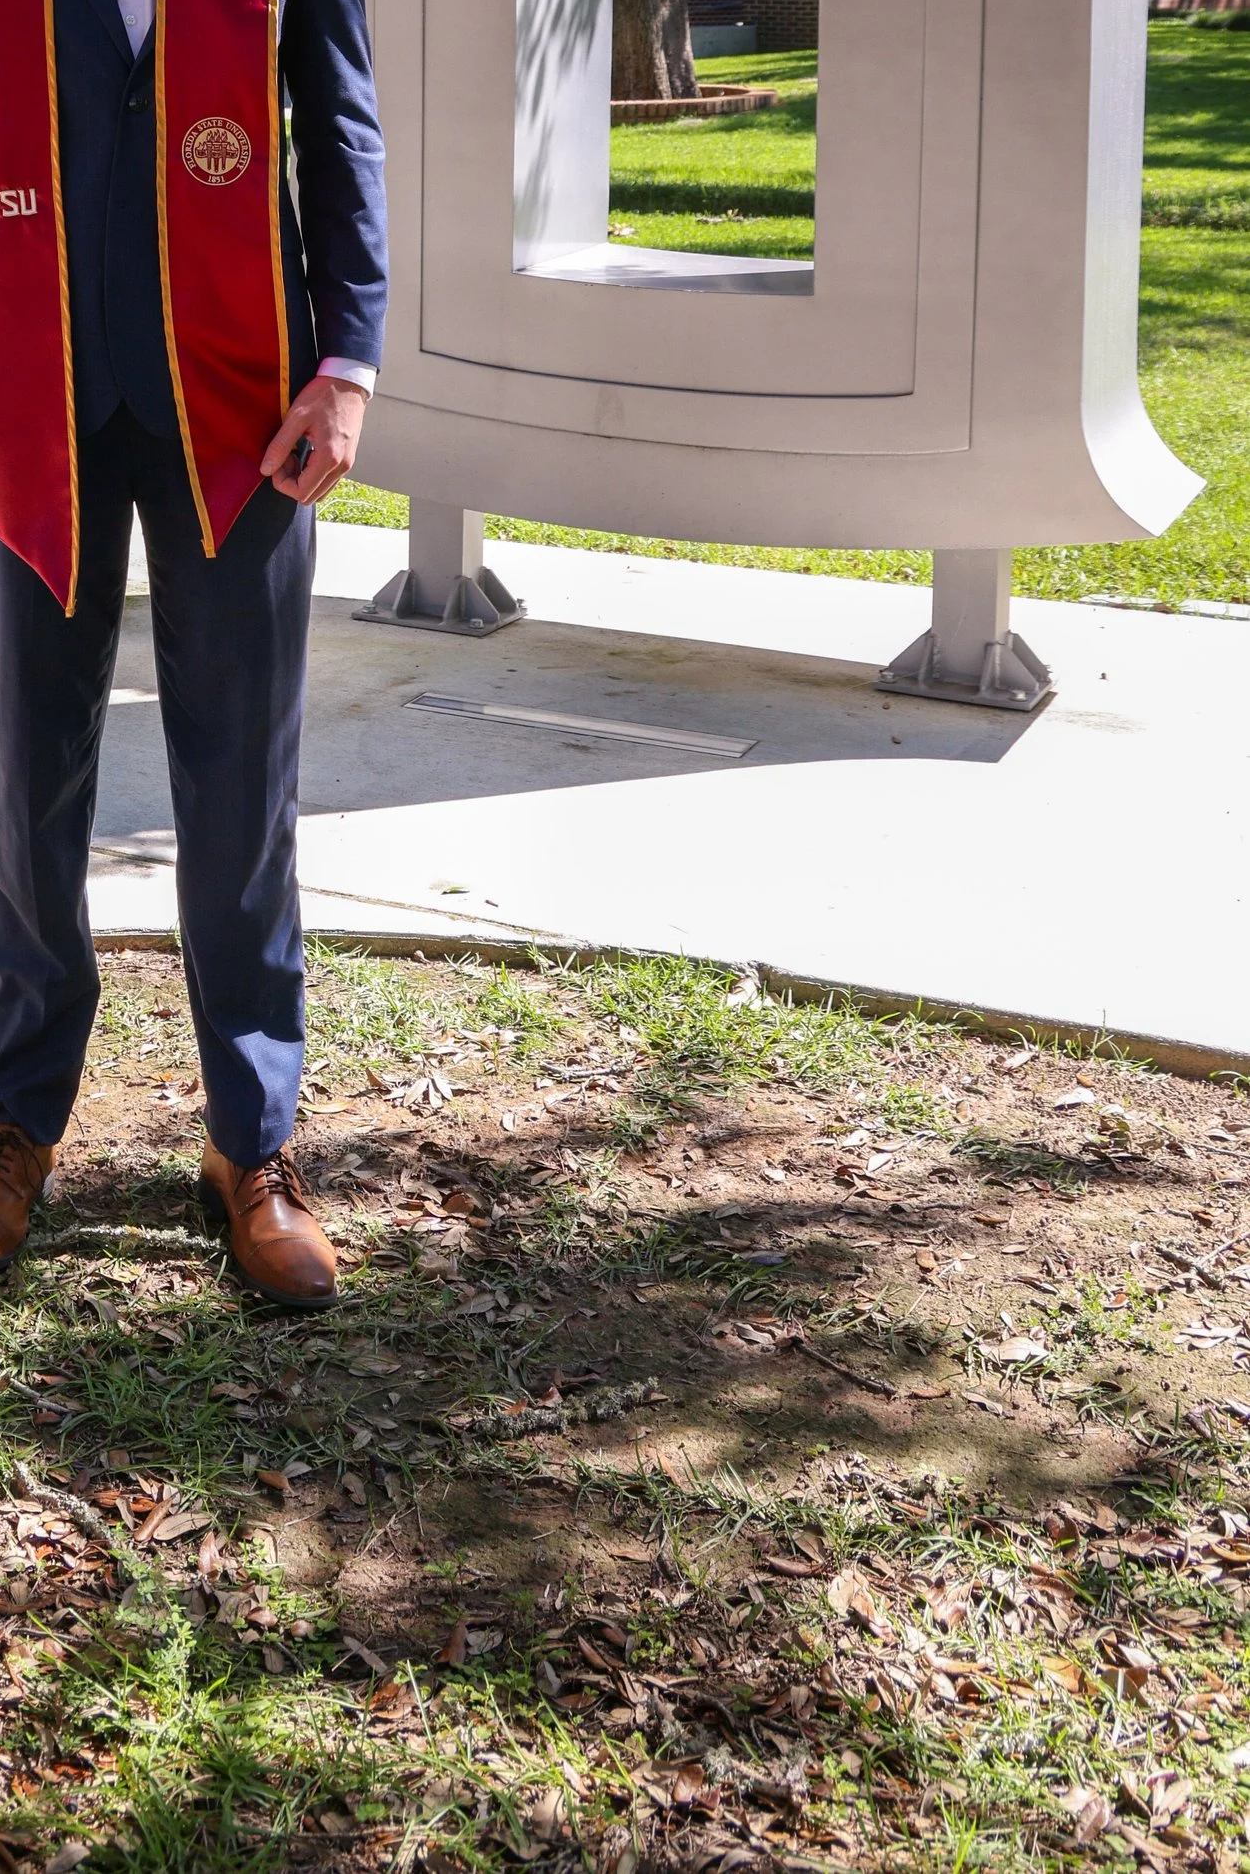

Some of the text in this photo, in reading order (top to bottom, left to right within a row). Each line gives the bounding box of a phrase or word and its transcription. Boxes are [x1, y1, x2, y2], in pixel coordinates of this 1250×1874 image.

[184, 119, 249, 170] FLORIDA STATE UNIVERSITY
